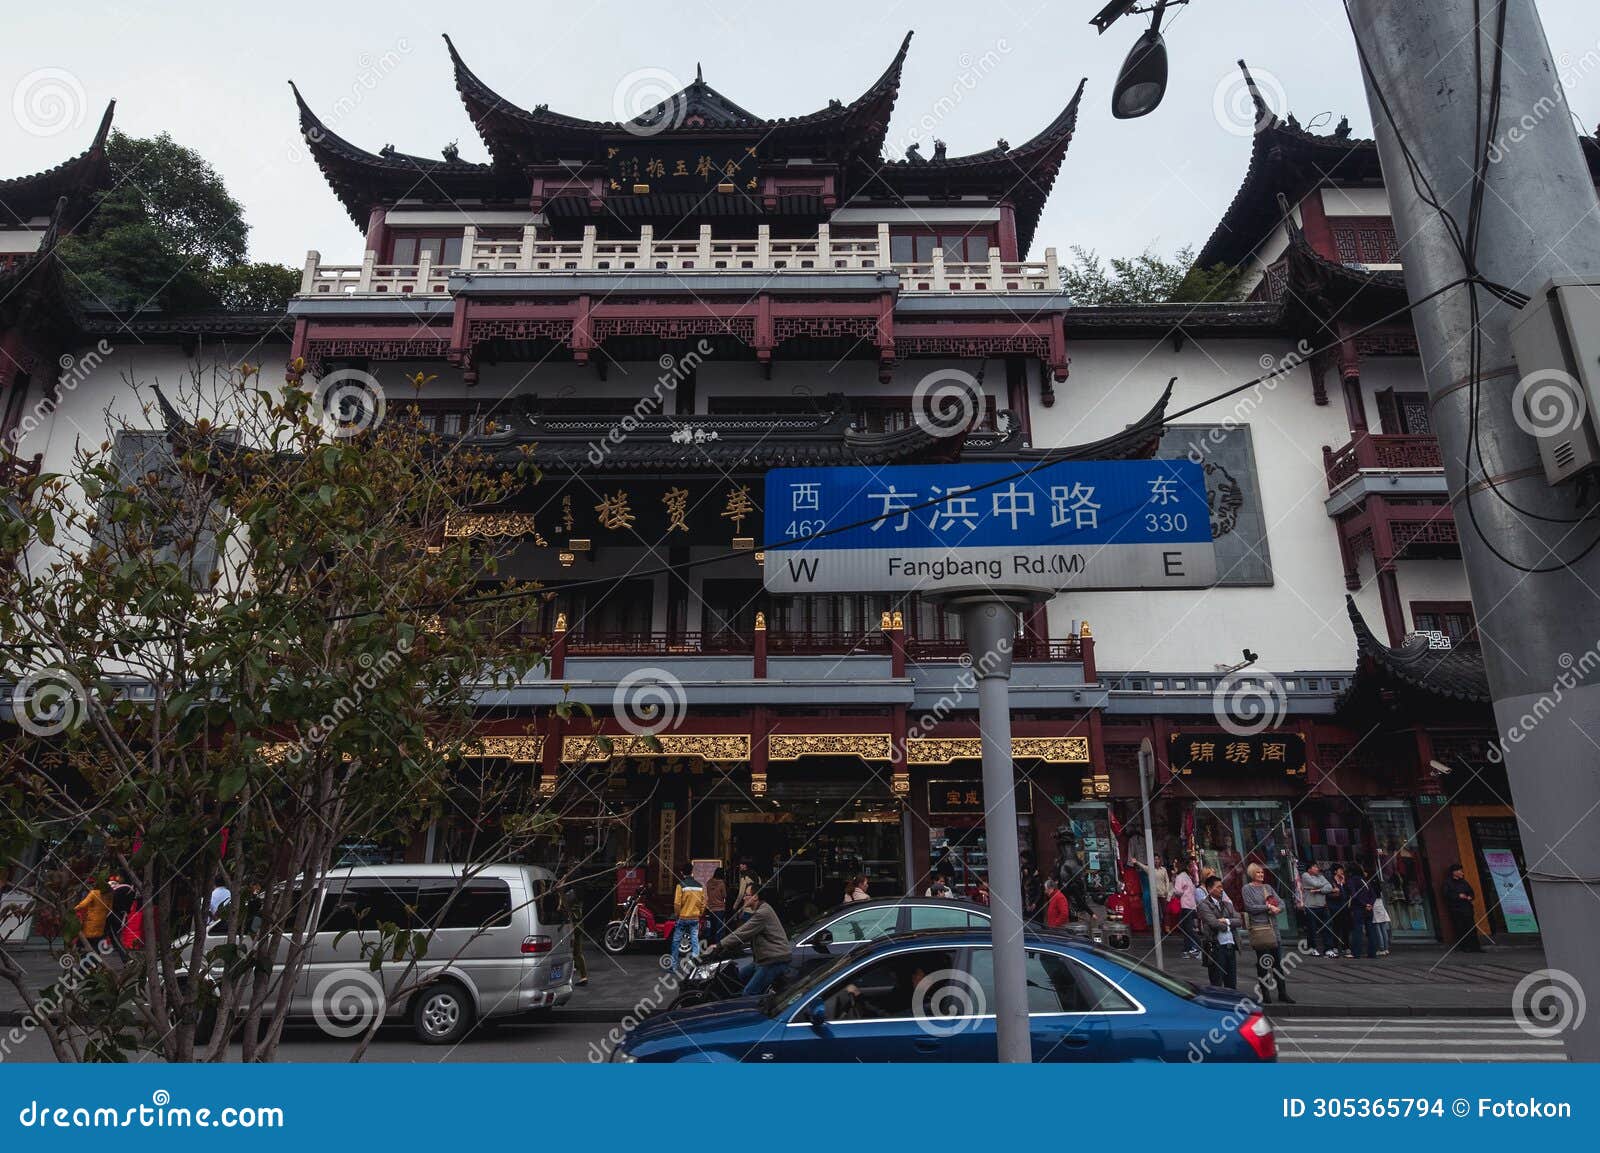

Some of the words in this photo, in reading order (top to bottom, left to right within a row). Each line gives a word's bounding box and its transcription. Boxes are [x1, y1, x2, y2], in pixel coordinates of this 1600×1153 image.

[789, 482, 822, 512] 西
[1147, 475, 1179, 506] 东
[867, 482, 1101, 533] 方浜中路
[784, 520, 827, 539] 462
[1145, 513, 1188, 533] 330
[787, 558, 820, 583] W
[887, 557, 1002, 581] Fangbang
[1163, 551, 1186, 577] E
